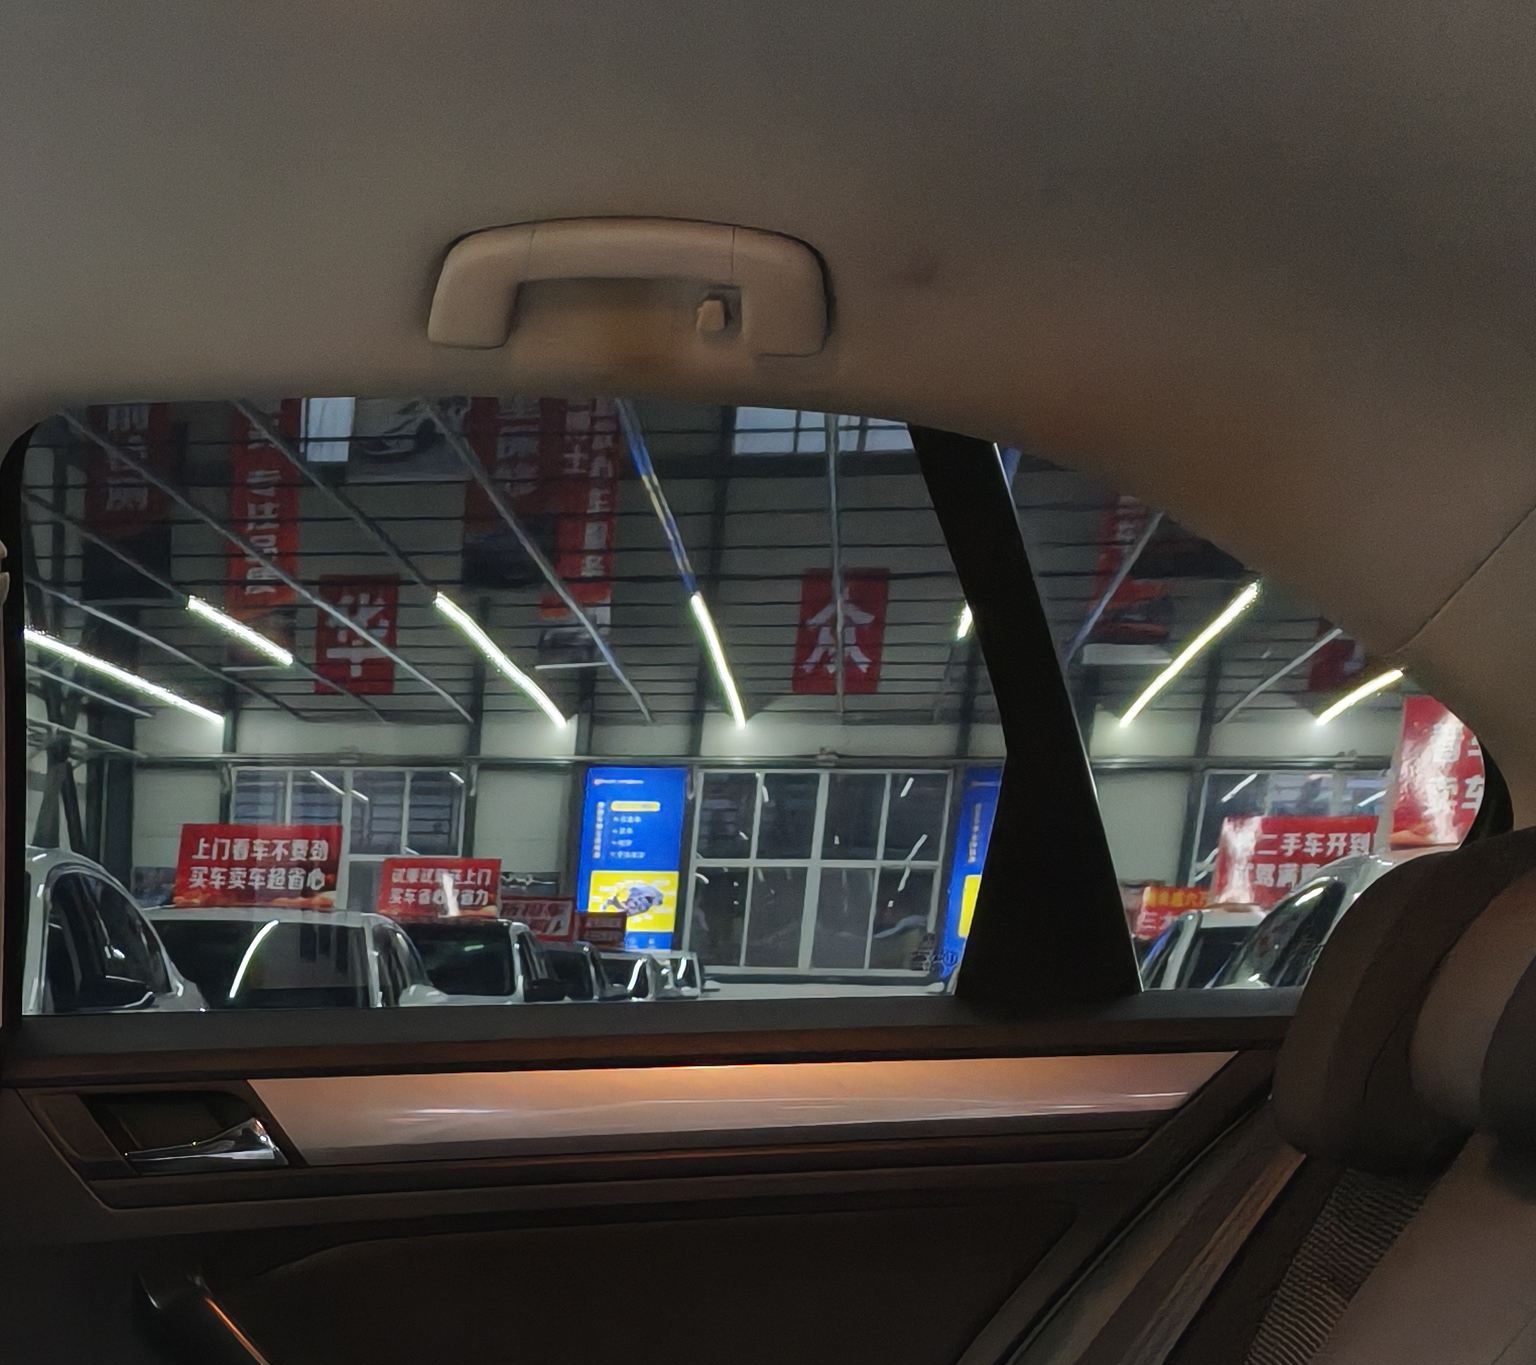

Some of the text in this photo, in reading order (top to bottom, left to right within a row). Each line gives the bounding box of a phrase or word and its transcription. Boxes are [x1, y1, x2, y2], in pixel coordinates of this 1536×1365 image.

[191, 837, 330, 862] 上门看车不费劲
[188, 865, 326, 891] 买车卖车超省心
